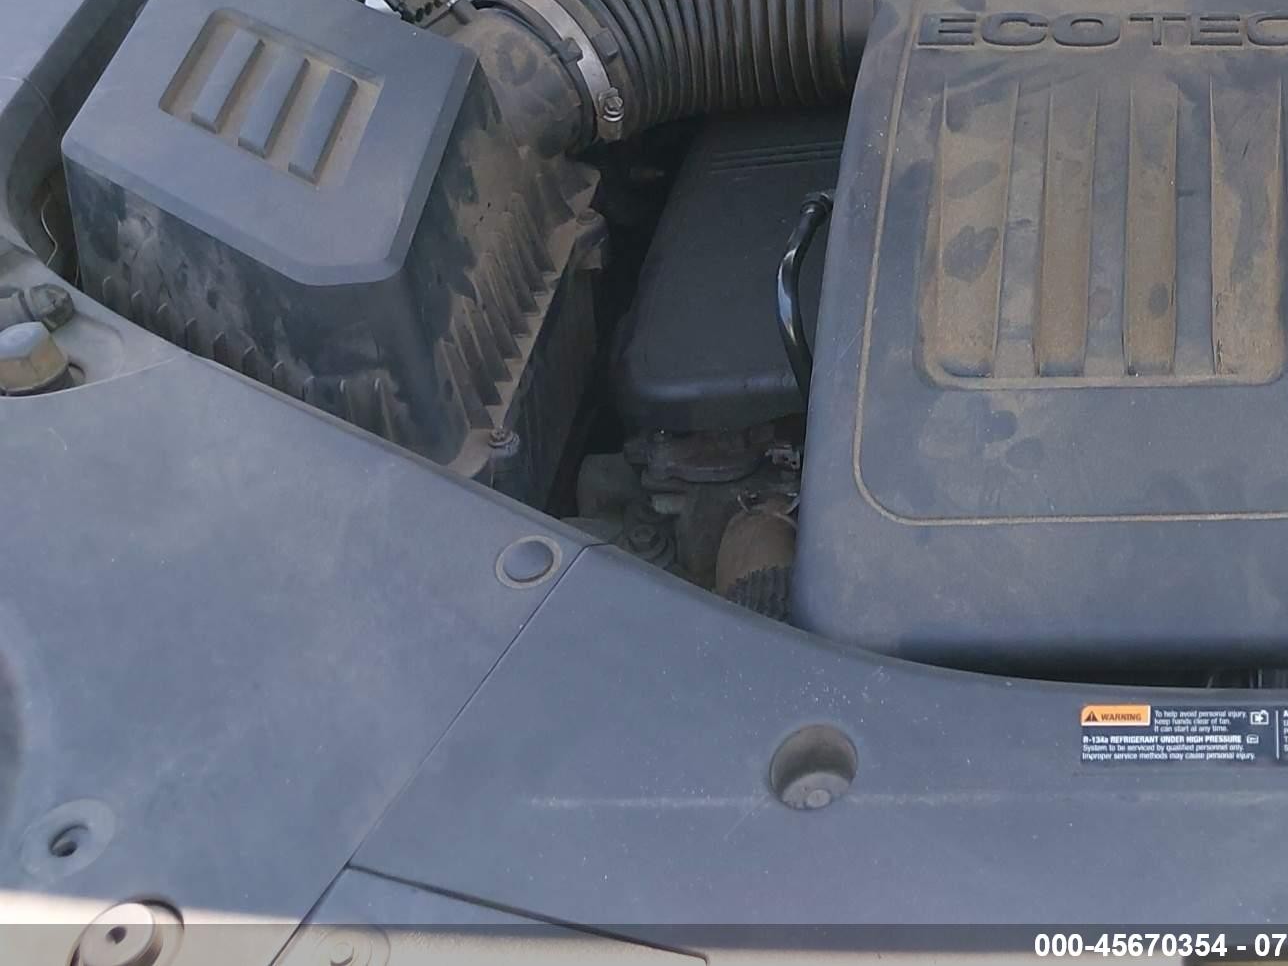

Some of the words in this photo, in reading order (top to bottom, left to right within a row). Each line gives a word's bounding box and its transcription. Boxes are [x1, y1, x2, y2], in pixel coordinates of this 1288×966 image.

[1100, 713, 1142, 721] WARNING
[1155, 710, 1162, 718] To
[1164, 710, 1177, 718] help
[1198, 710, 1226, 718] personal
[1210, 718, 1217, 726] of
[1110, 736, 1158, 744] REFRIGERANT
[1160, 736, 1184, 744] UNDER
[1186, 735, 1203, 743] HIGH
[1205, 735, 1242, 743] PRESSURE
[1083, 745, 1107, 753] System
[1117, 745, 1125, 753] be
[1127, 745, 1154, 753] serviced
[1156, 745, 1164, 753] by
[1166, 744, 1194, 752] qualified
[1195, 744, 1228, 752] personnel
[1082, 753, 1112, 761] Improper
[1113, 753, 1137, 761] service
[1139, 753, 1168, 761] methods
[1169, 753, 1184, 761] may
[1206, 752, 1234, 760] personal
